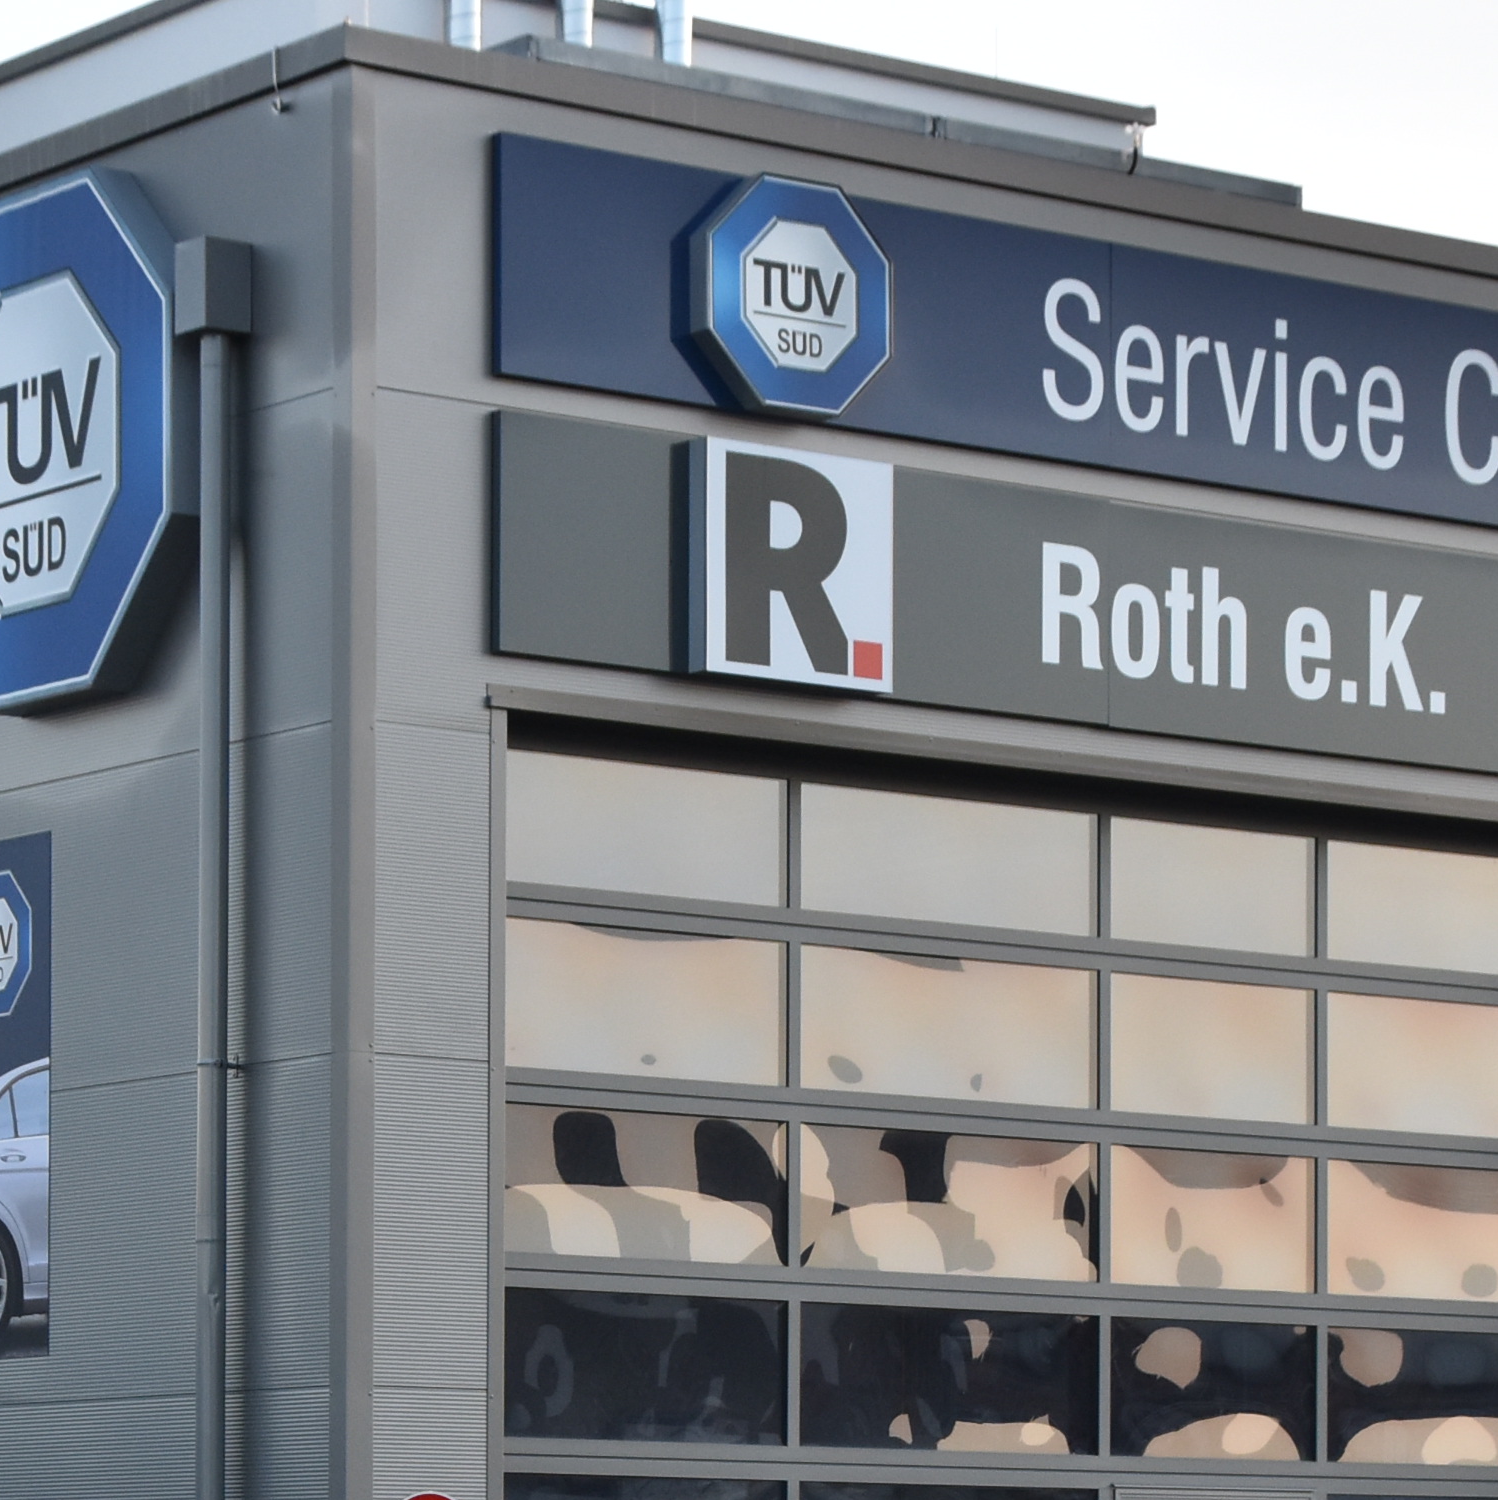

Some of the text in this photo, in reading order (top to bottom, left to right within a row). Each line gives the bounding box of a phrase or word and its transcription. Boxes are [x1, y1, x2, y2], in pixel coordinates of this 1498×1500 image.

[753, 257, 845, 317] TÜV
[777, 326, 823, 359] SÜD
[1042, 277, 1405, 470] Service
[2, 514, 67, 583] SÜD
[1041, 541, 1447, 715] Roth e.K.
